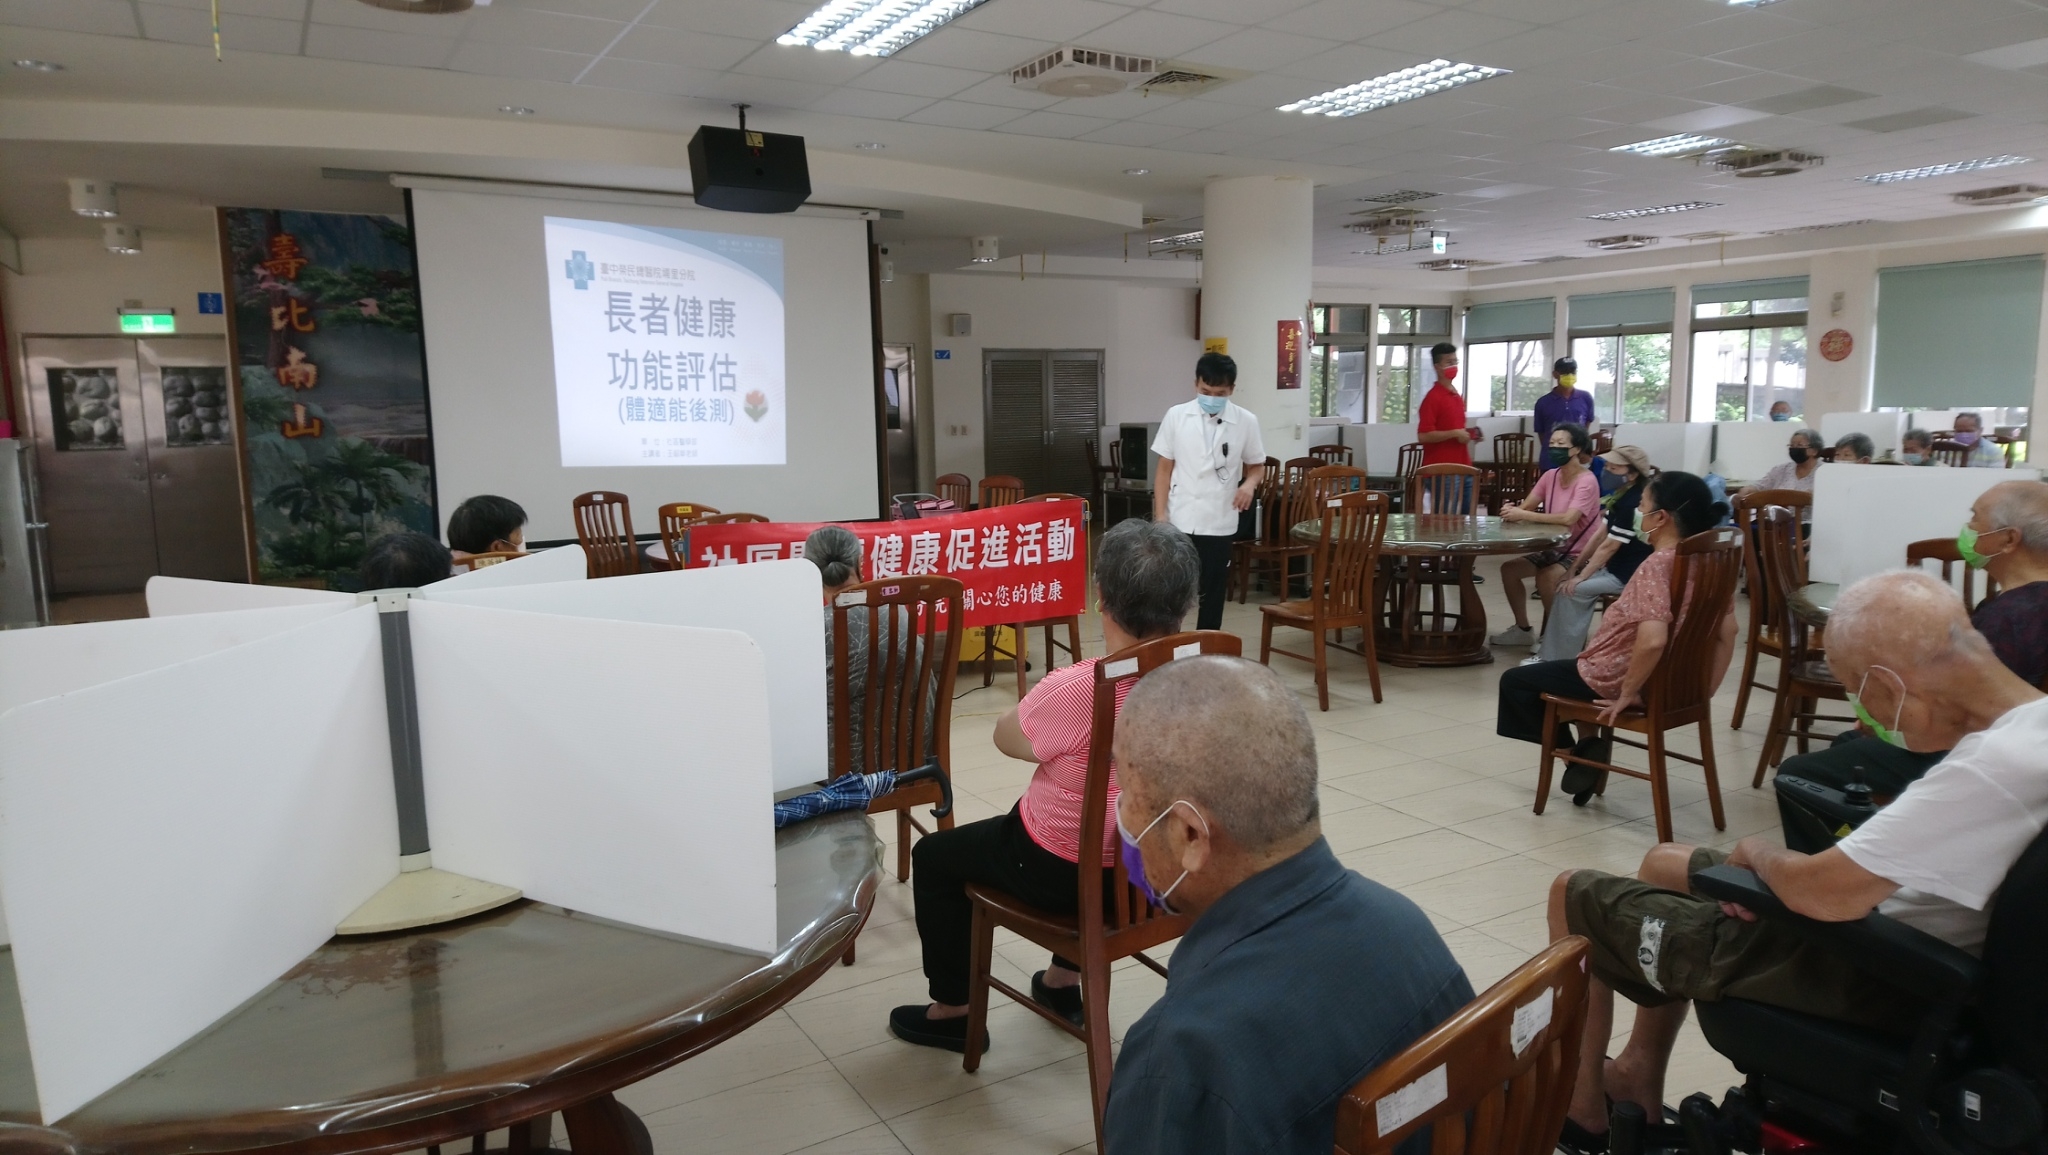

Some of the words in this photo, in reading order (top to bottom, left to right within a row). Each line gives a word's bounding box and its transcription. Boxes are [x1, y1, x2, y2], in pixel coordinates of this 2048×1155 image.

[262, 234, 322, 438] 壽比南山
[604, 290, 736, 339] 長者健康
[607, 349, 738, 392] 功能評估
[618, 396, 735, 426] (體適能後測)
